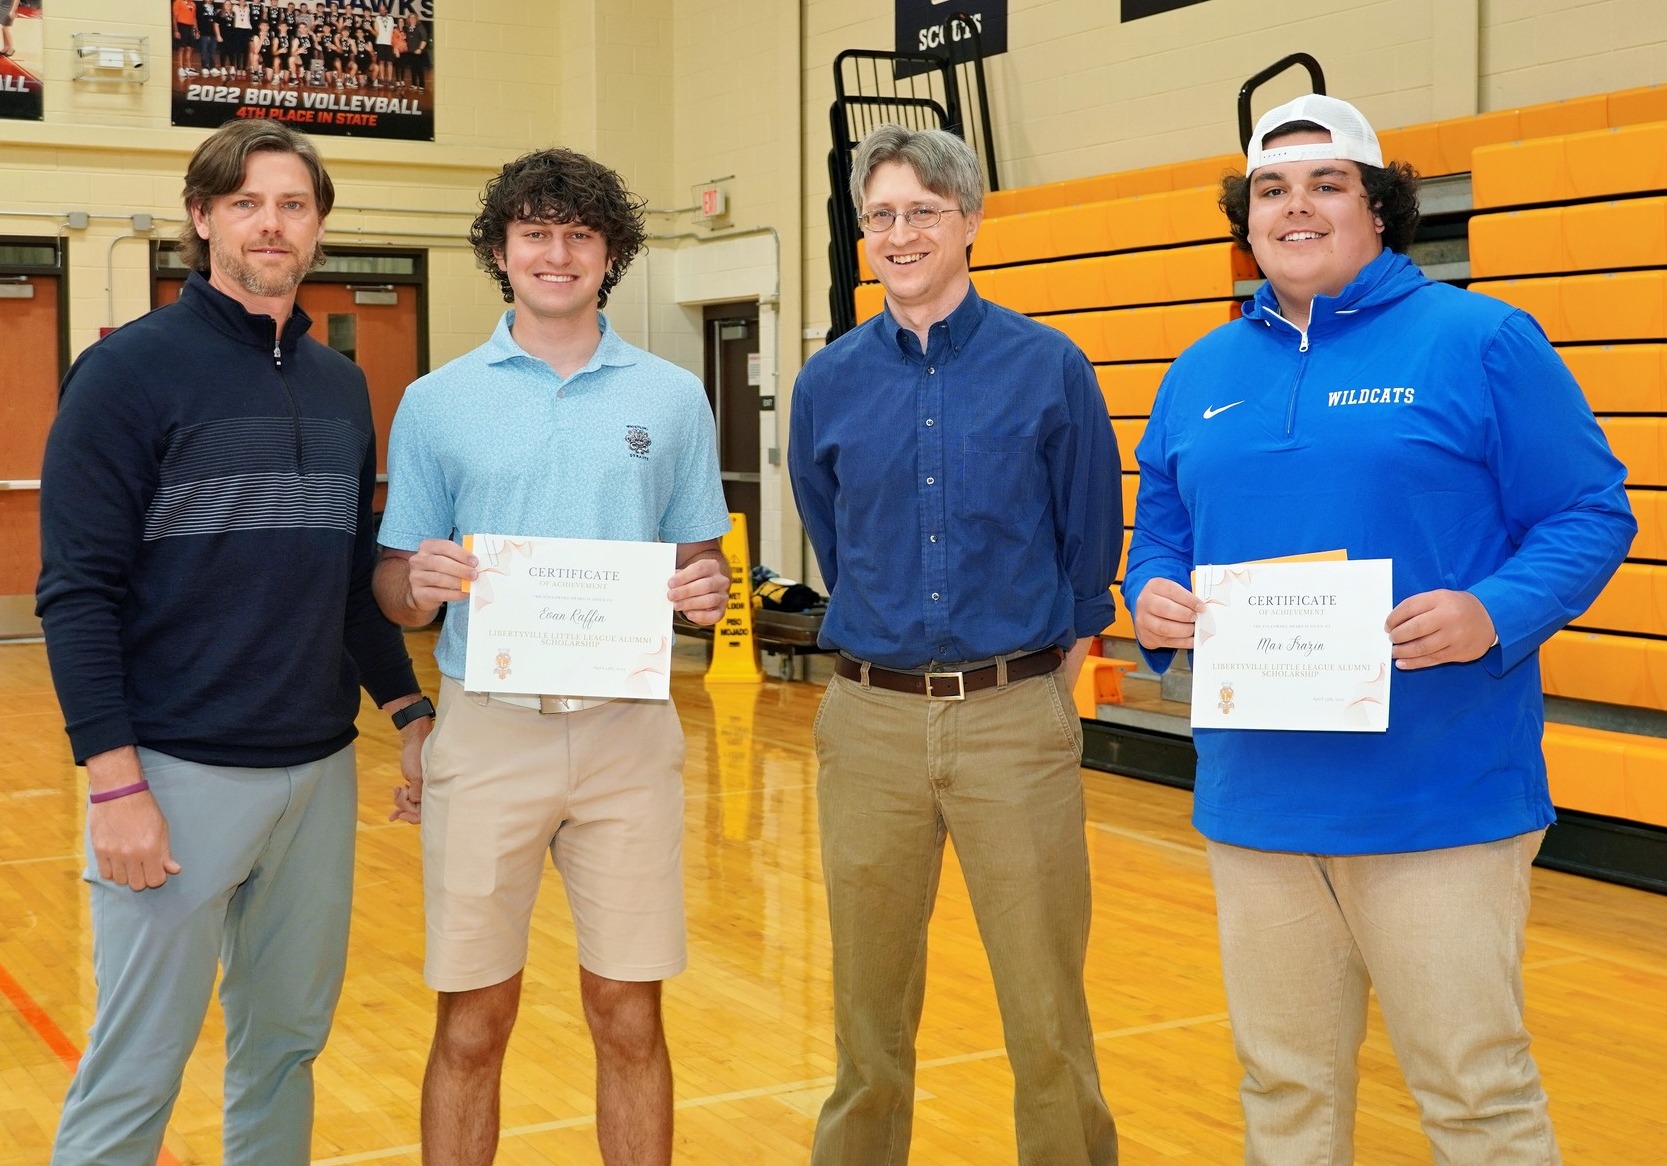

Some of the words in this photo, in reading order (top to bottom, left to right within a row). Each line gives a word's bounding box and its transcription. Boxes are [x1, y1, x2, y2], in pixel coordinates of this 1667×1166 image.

[187, 84, 241, 103] 2022
[244, 88, 299, 107] BOYS
[303, 91, 422, 115] VOLLEYBALL
[236, 106, 266, 119] 4TH
[269, 108, 316, 123] PLACE
[317, 111, 333, 123] IN
[336, 112, 378, 126] STATE
[1328, 387, 1415, 407] WILDCATS
[528, 566, 620, 581] CERTIFICATE
[539, 580, 551, 588] OF
[551, 581, 608, 590] ACHIEVEMENT
[1248, 594, 1337, 606] CERTIFICATE
[727, 602, 745, 610] LOOR
[1258, 608, 1269, 616] OF
[1271, 608, 1325, 616] ACHIEVEMENT
[539, 606, 566, 621] Evan
[569, 608, 606, 630] Raffin
[726, 618, 743, 626] PISO
[488, 629, 549, 639] LIBERTYVILLE
[551, 632, 581, 640] LITTLE
[583, 633, 617, 642] LEAGUE
[619, 635, 652, 644] ALUMNI
[720, 628, 748, 636] MOJADO
[541, 638, 600, 648] SCHOLARSHIP
[1212, 662, 1269, 671] LIBERTYVILLE
[1271, 663, 1301, 671] LITTLE
[1302, 663, 1335, 671] LEAGUE
[1337, 664, 1371, 672] ALUMNI
[1262, 670, 1320, 678] SCHOLARSHIP
